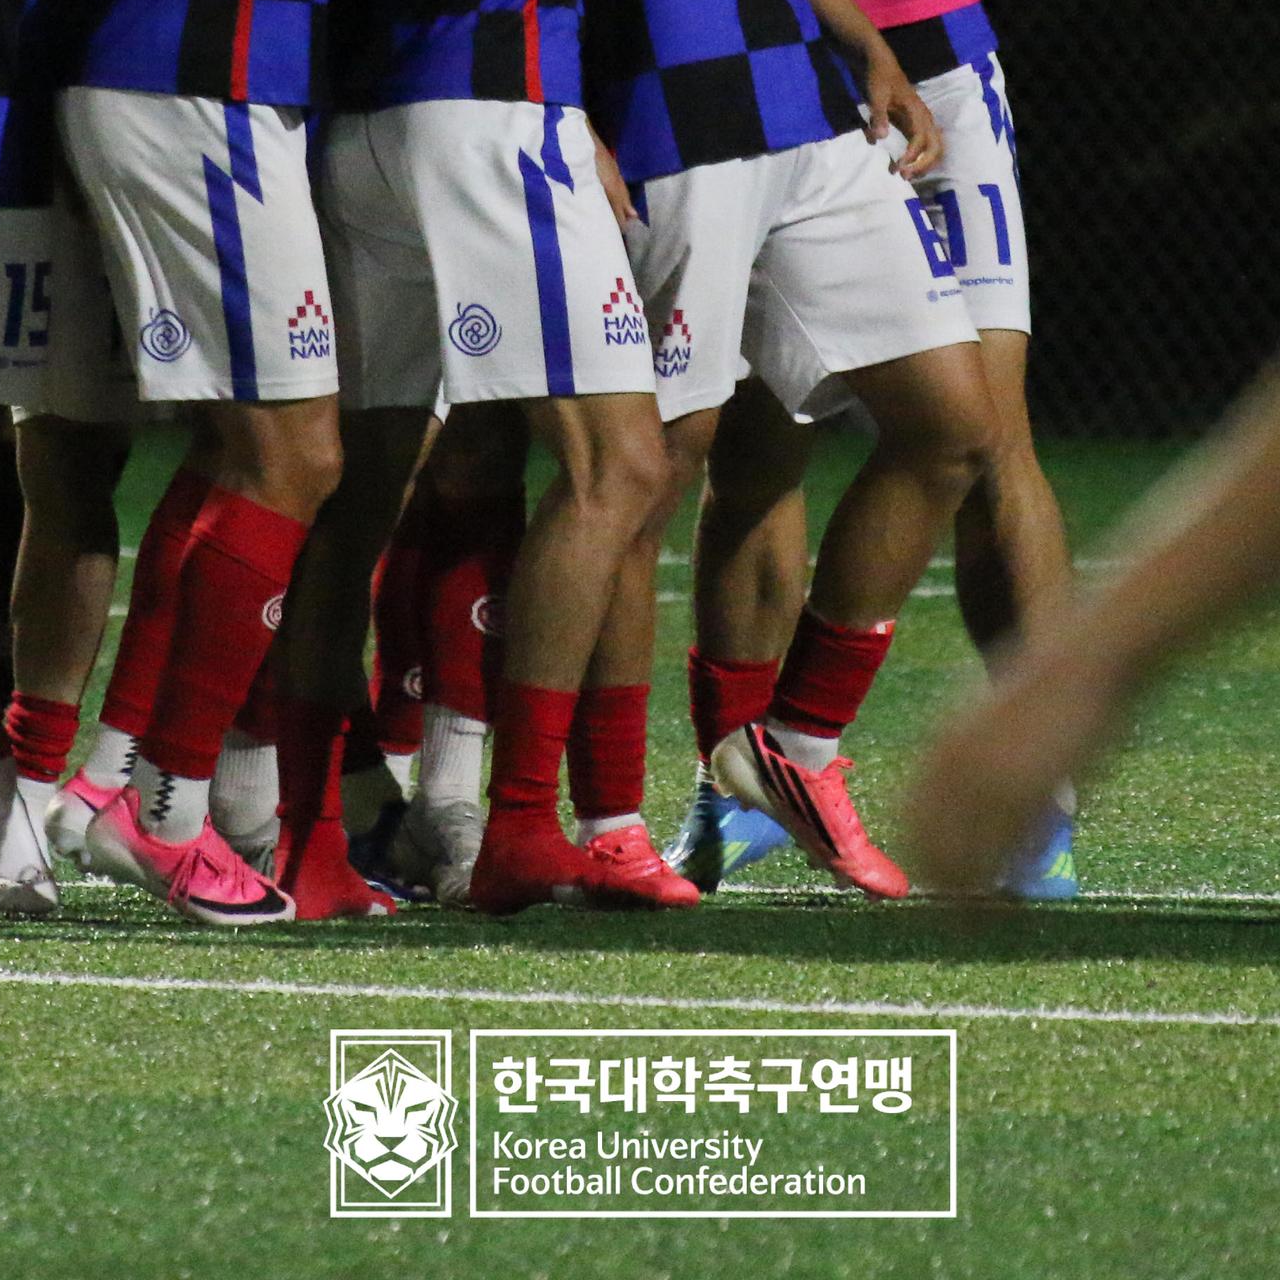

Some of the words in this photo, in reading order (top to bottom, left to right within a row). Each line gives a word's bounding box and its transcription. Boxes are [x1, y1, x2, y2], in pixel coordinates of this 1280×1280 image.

[3, 261, 52, 348] 15
[603, 313, 643, 330] HAN
[289, 327, 330, 343] HAN
[605, 330, 646, 346] NAM
[290, 343, 330, 360] NAM
